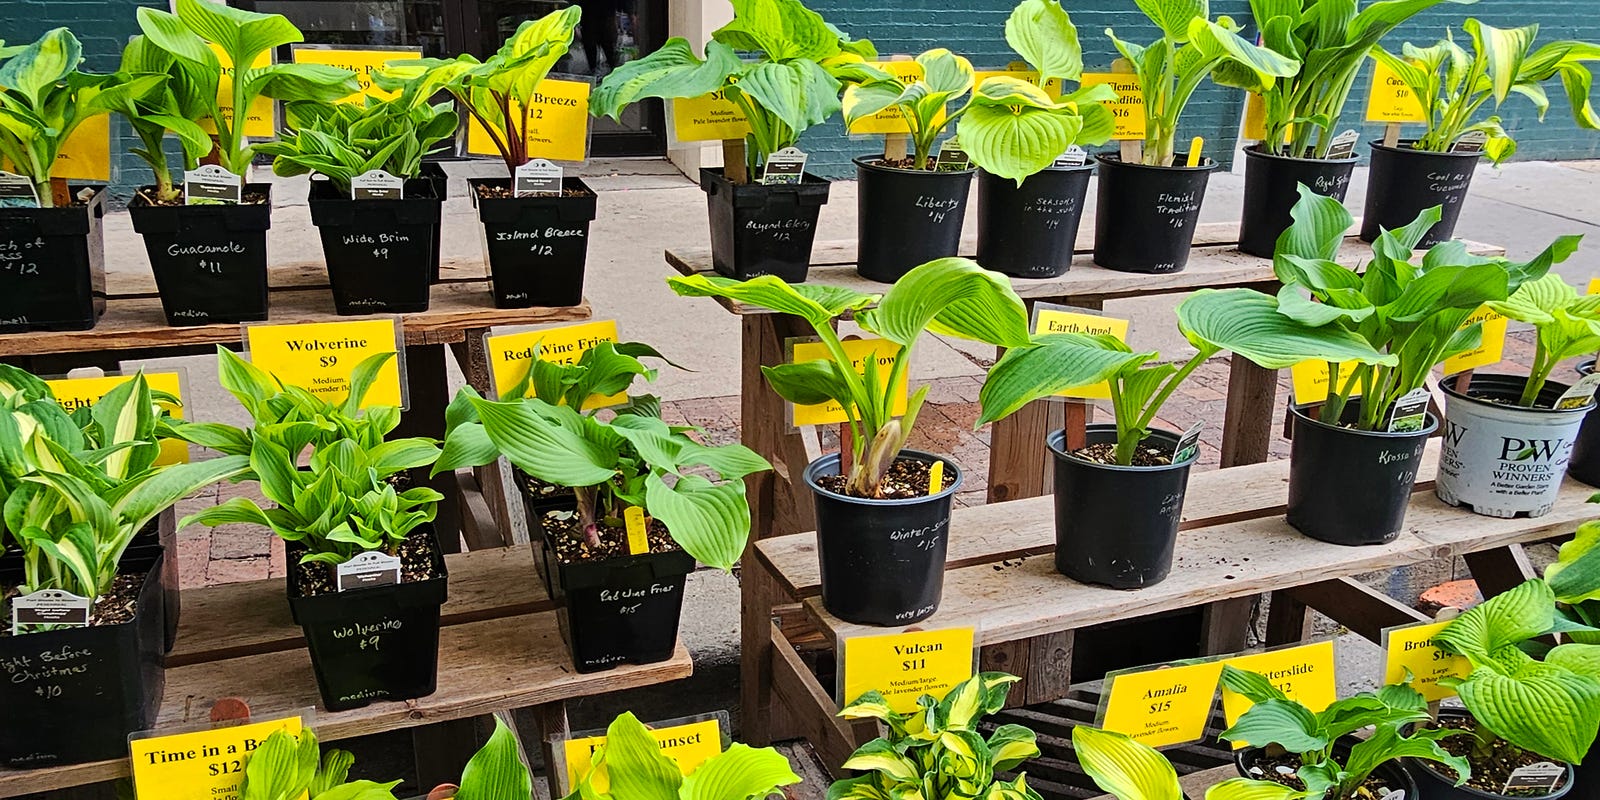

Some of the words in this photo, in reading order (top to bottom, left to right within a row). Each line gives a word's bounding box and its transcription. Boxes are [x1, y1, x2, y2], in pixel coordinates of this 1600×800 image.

[1108, 82, 1142, 92] Flemis
[1395, 89, 1409, 98] $10
[533, 92, 577, 107] Breeze
[711, 90, 723, 100] $1
[529, 108, 543, 119] 12
[875, 112, 900, 120] Lavender
[1112, 109, 1129, 118] $16
[1426, 172, 1450, 181] Cool
[915, 195, 960, 212] Liberty
[1158, 191, 1196, 203] Flemish
[1036, 205, 1053, 213] the
[928, 210, 946, 224] $14
[1169, 218, 1183, 229] $16
[342, 234, 375, 245] Wide
[378, 231, 410, 243] Brim
[495, 229, 539, 241] Island
[167, 240, 246, 256] Guacamole
[372, 247, 389, 260] $9
[530, 244, 554, 256] $12
[199, 259, 222, 273] $11
[173, 308, 209, 318] medium
[1048, 319, 1080, 334] Earth
[1461, 315, 1475, 328] ast
[286, 338, 368, 352] Wolverine
[503, 347, 532, 362] Red
[540, 342, 575, 356] Wine
[319, 355, 338, 368] $9
[312, 377, 348, 385] Medium.
[58, 397, 93, 413] ight
[1497, 436, 1564, 463] PW
[1499, 462, 1551, 473] PROVEN
[889, 524, 930, 541] Winter
[917, 535, 938, 551] $15
[600, 589, 620, 602] Red
[621, 588, 646, 598] Wine
[619, 602, 643, 615] $15
[332, 616, 403, 639] Wolverine
[359, 635, 381, 651] $9
[893, 641, 944, 656] Vulcan
[39, 645, 92, 662] Before
[902, 658, 926, 672] $11
[11, 663, 88, 684] Christmas
[34, 685, 62, 699] $10
[339, 688, 391, 702] medium
[893, 686, 922, 695] lavender
[923, 683, 949, 692] flowers.
[1142, 683, 1188, 700] Amalia
[1148, 700, 1173, 715] $15
[659, 731, 702, 750] unset
[144, 750, 197, 765] Time
[202, 744, 220, 758] in
[226, 743, 237, 754] a
[208, 760, 243, 777] $12
